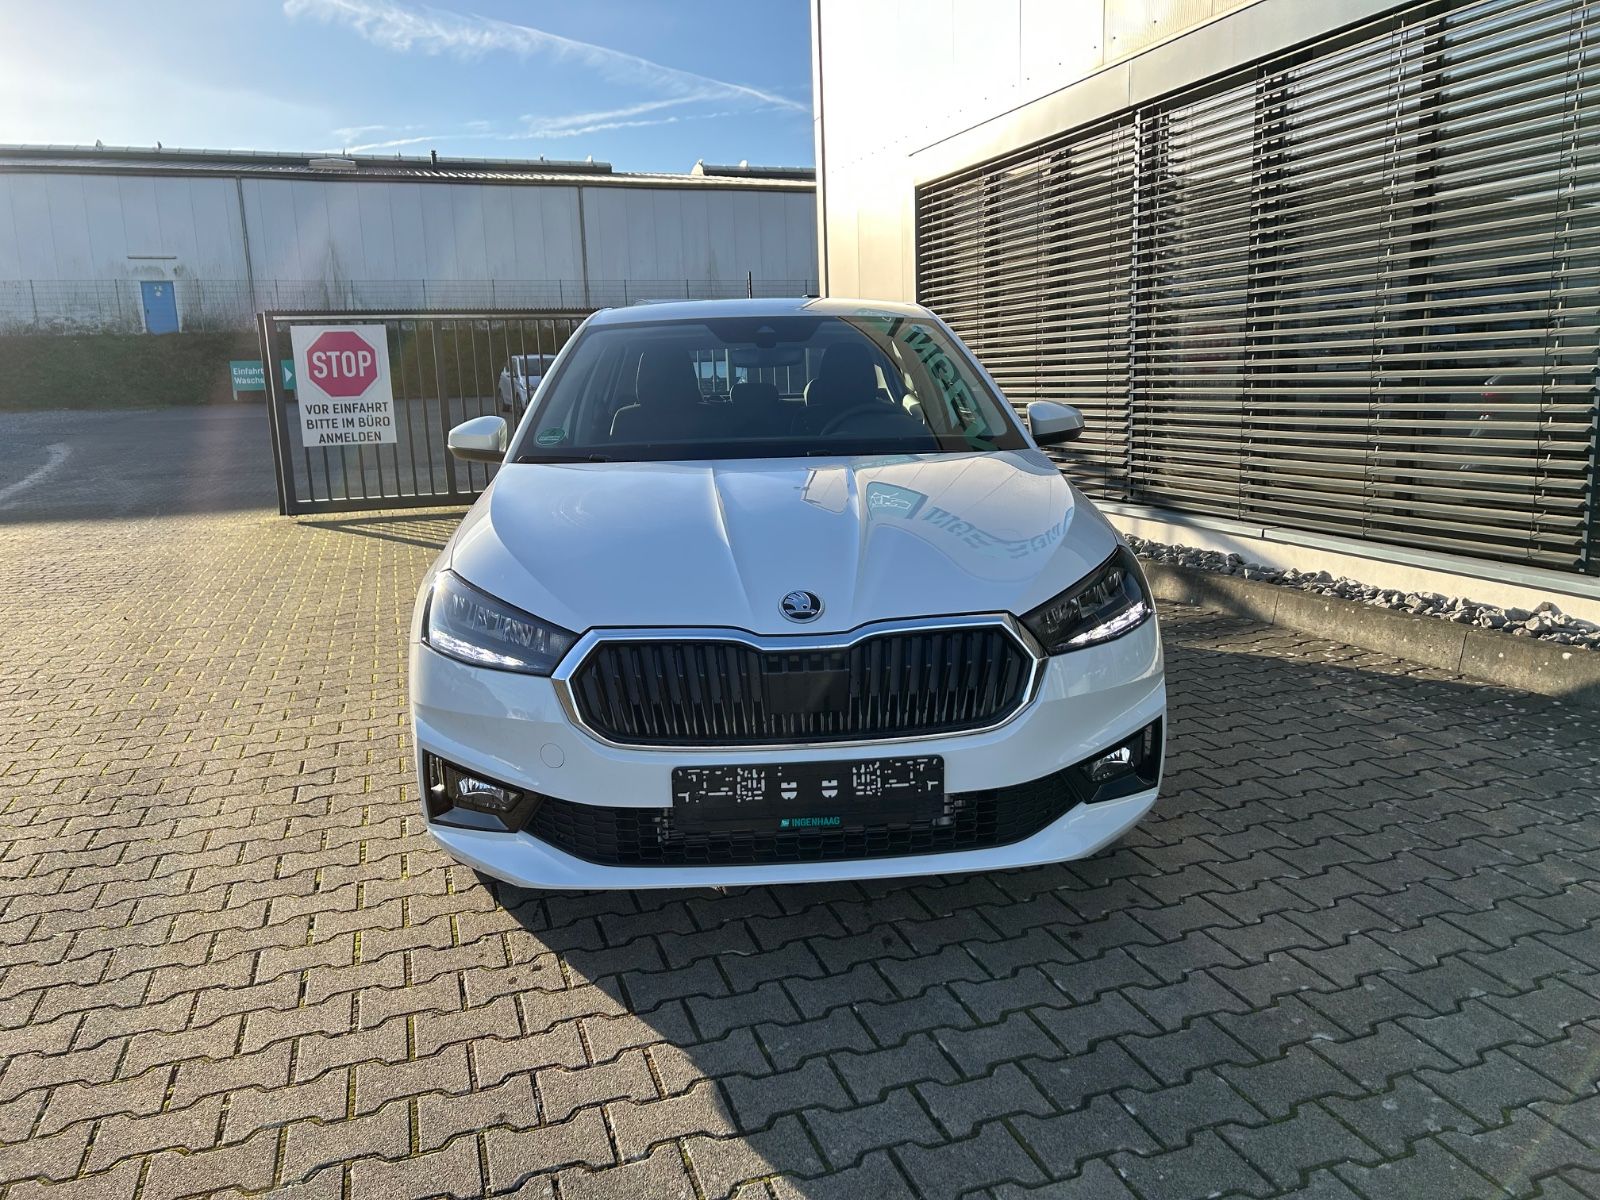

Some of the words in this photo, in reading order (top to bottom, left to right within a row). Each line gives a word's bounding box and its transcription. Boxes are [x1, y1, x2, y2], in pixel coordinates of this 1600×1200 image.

[312, 350, 371, 378] STOP
[305, 404, 329, 415] VOR
[333, 402, 388, 414] EINFAHRT
[307, 418, 338, 430] BITTE
[342, 418, 355, 428] IM
[359, 415, 390, 428] BÜRO
[319, 432, 381, 444] ANMELDEN
[792, 816, 840, 827] INGENHAAG
